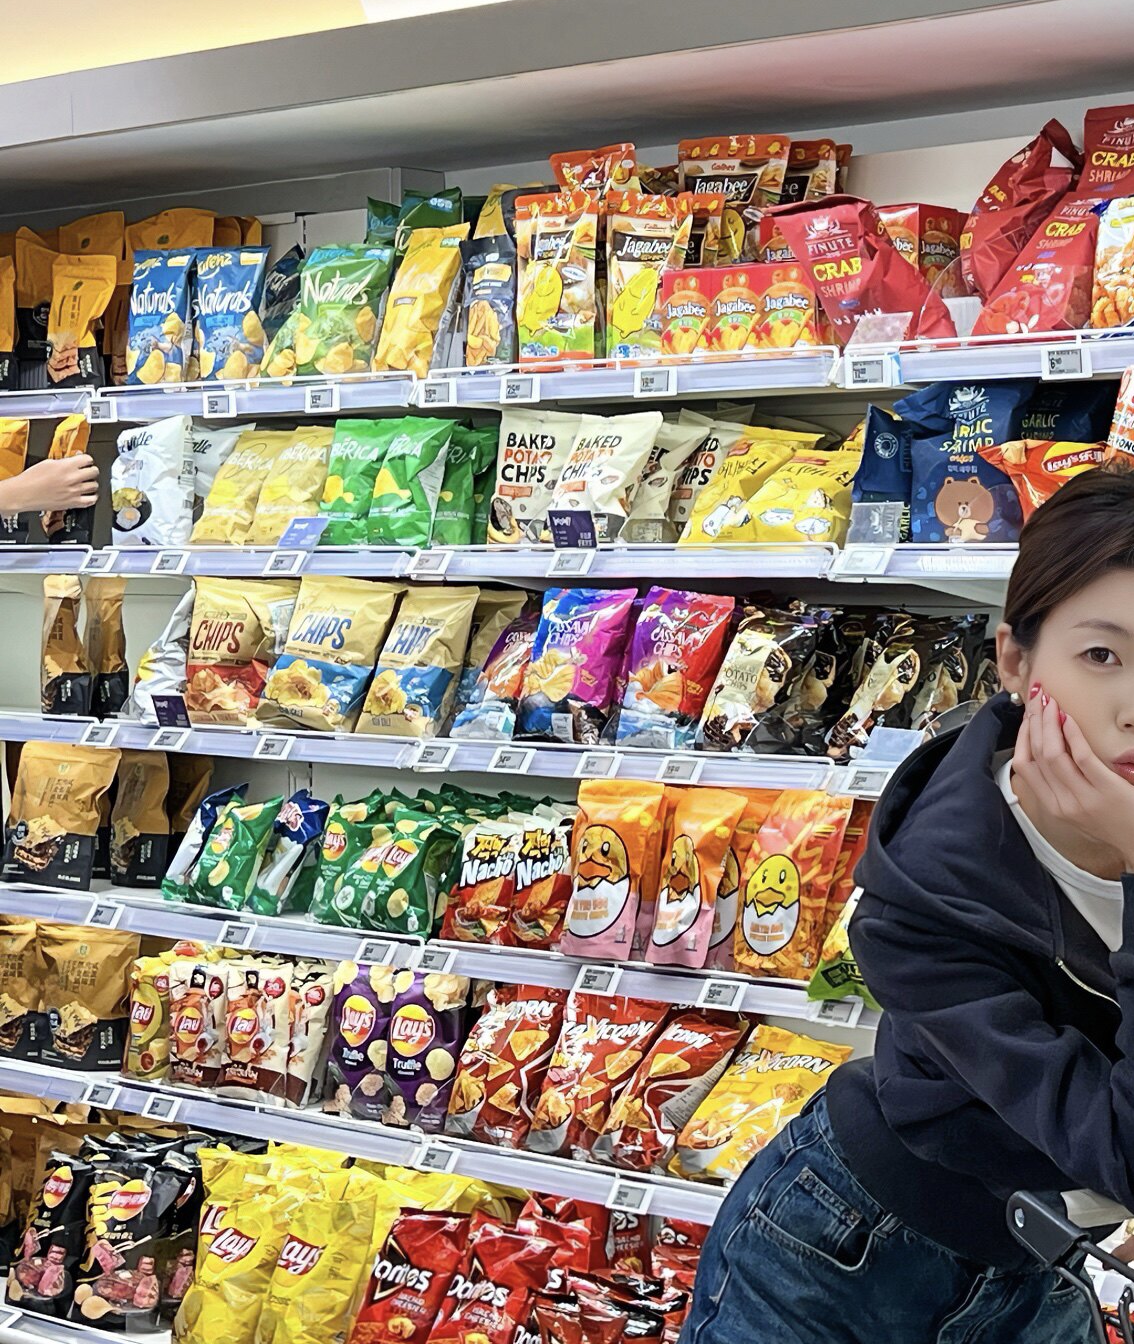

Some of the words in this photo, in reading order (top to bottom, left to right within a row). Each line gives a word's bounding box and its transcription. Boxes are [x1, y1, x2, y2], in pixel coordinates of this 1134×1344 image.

[694, 178, 749, 195] Jagabee
[1045, 221, 1087, 237] CRAB
[617, 235, 674, 258] Jagabee
[766, 248, 797, 263] Jagab
[807, 237, 856, 256] FINUTE
[813, 256, 863, 282] CRAB
[198, 280, 252, 316] Naturals
[303, 270, 372, 307] Naturals
[715, 298, 757, 317] Jagabee
[764, 291, 810, 311] Jagabee
[666, 302, 707, 320] Jagabee
[1021, 413, 1061, 429] GARLIC
[506, 432, 556, 448] BAKED
[501, 464, 547, 483] CHIPS
[681, 468, 712, 486] HIPS
[192, 619, 244, 654] CHIPS
[292, 613, 352, 650] CHIPS
[548, 632, 584, 647] CHIPS
[652, 642, 684, 659] CHIPS
[460, 851, 514, 889] Nacho
[515, 852, 563, 891] Nacho
[393, 1057, 422, 1071] Truffle
[447, 1273, 510, 1308] Doritos
